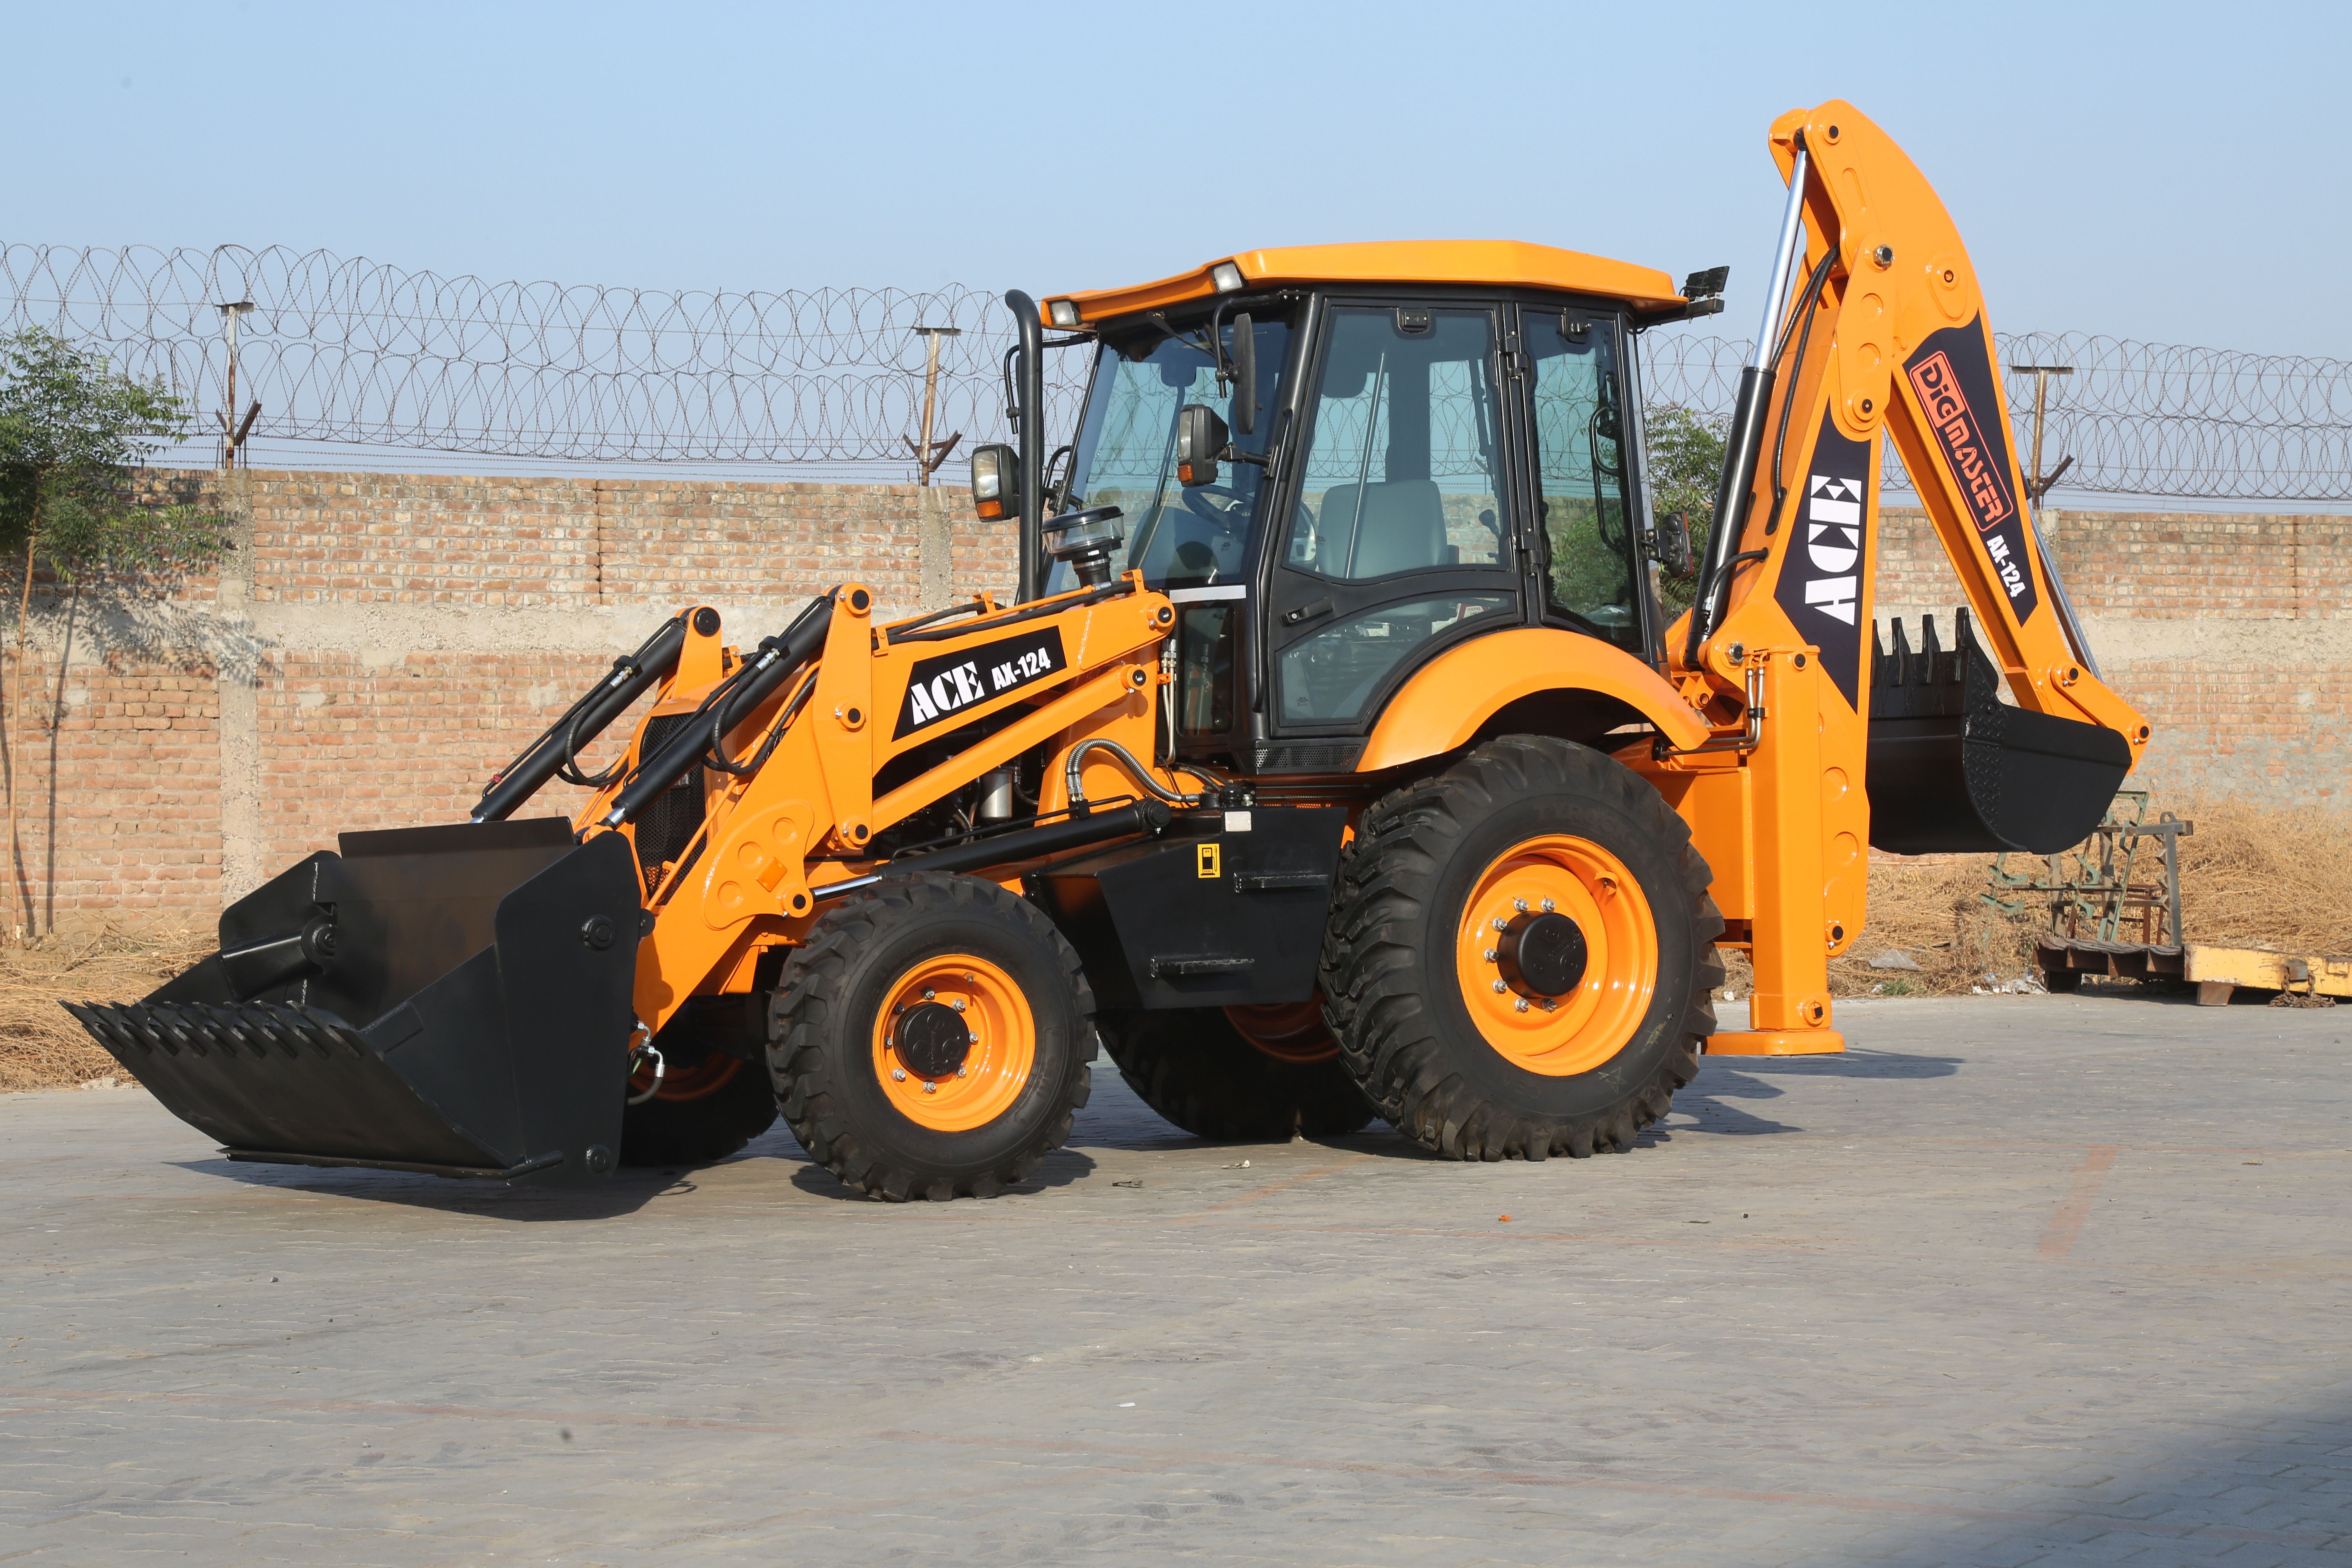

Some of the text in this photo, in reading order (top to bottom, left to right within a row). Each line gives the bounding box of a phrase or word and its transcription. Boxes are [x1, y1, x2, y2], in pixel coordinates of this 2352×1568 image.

[1805, 475, 1862, 626] ACE
[1987, 535, 2026, 598] AX-124
[911, 647, 1051, 725] ACE AX-124
